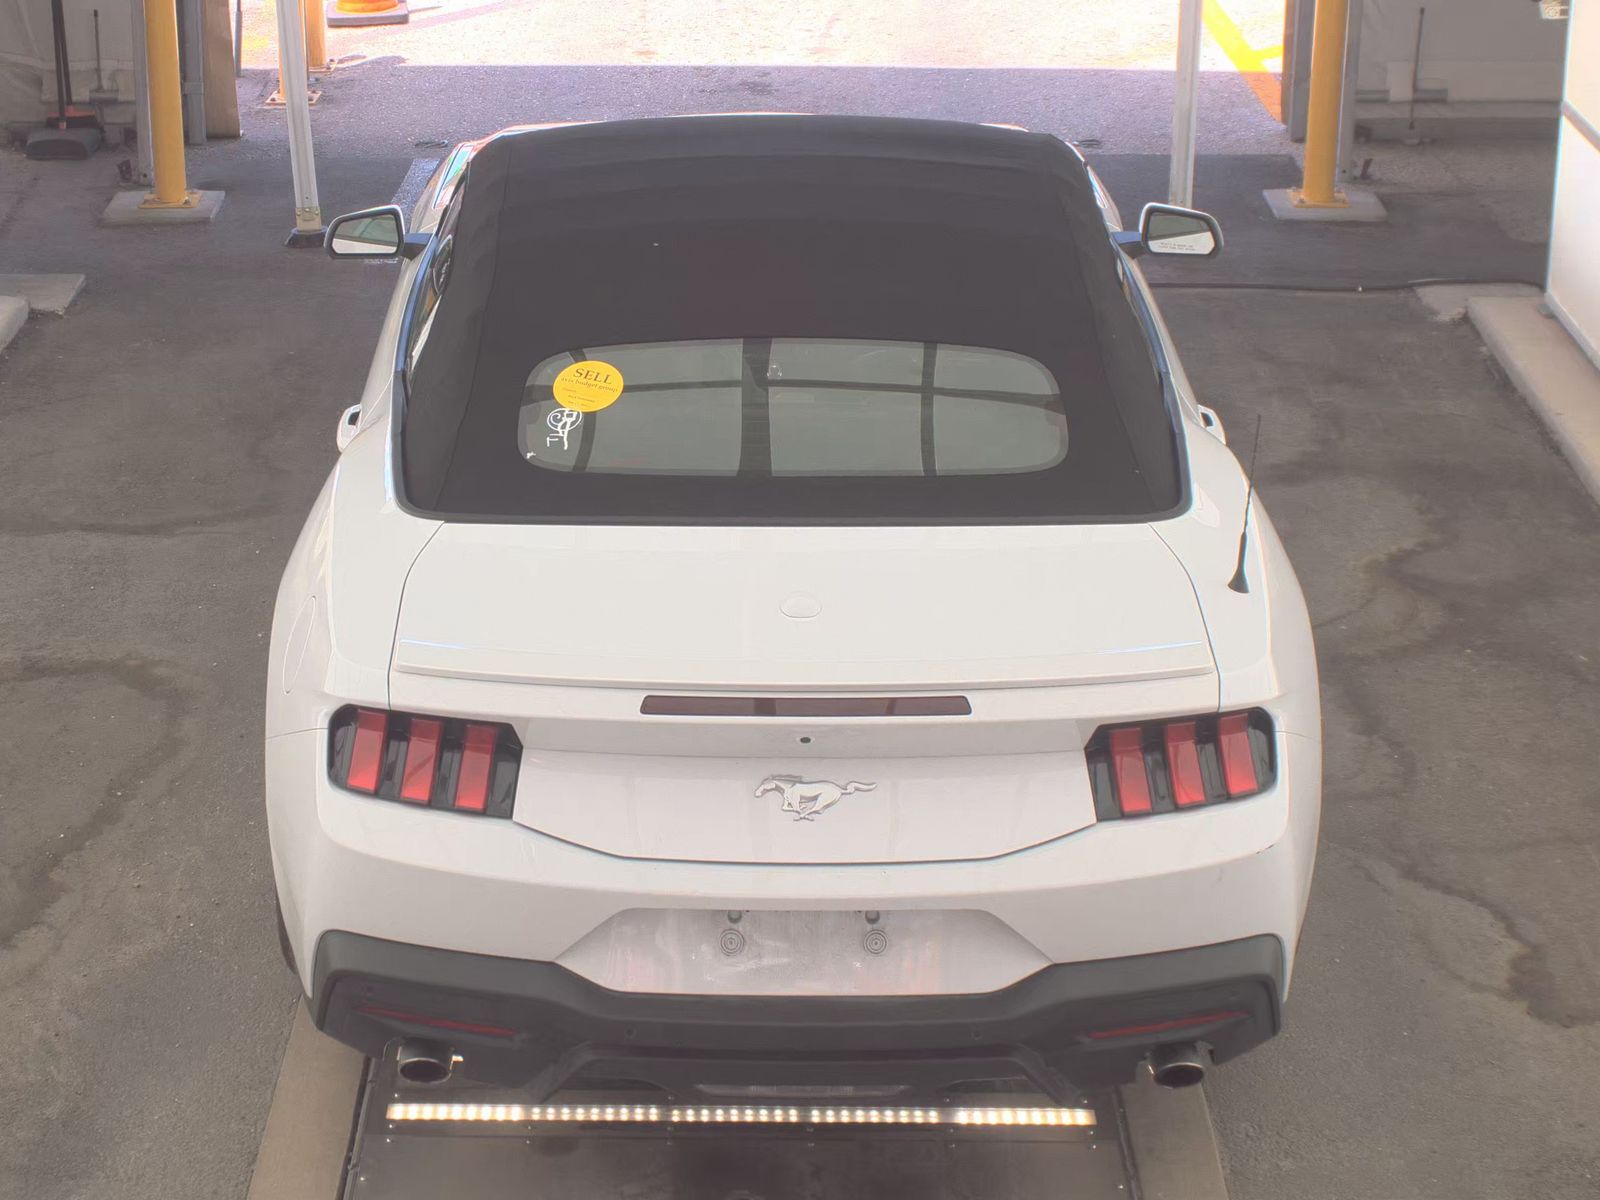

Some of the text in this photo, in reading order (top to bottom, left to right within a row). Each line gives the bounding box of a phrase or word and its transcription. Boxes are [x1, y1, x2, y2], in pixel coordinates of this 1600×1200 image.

[573, 367, 612, 385] SELL
[575, 379, 598, 389] budget
[598, 384, 618, 393] group
